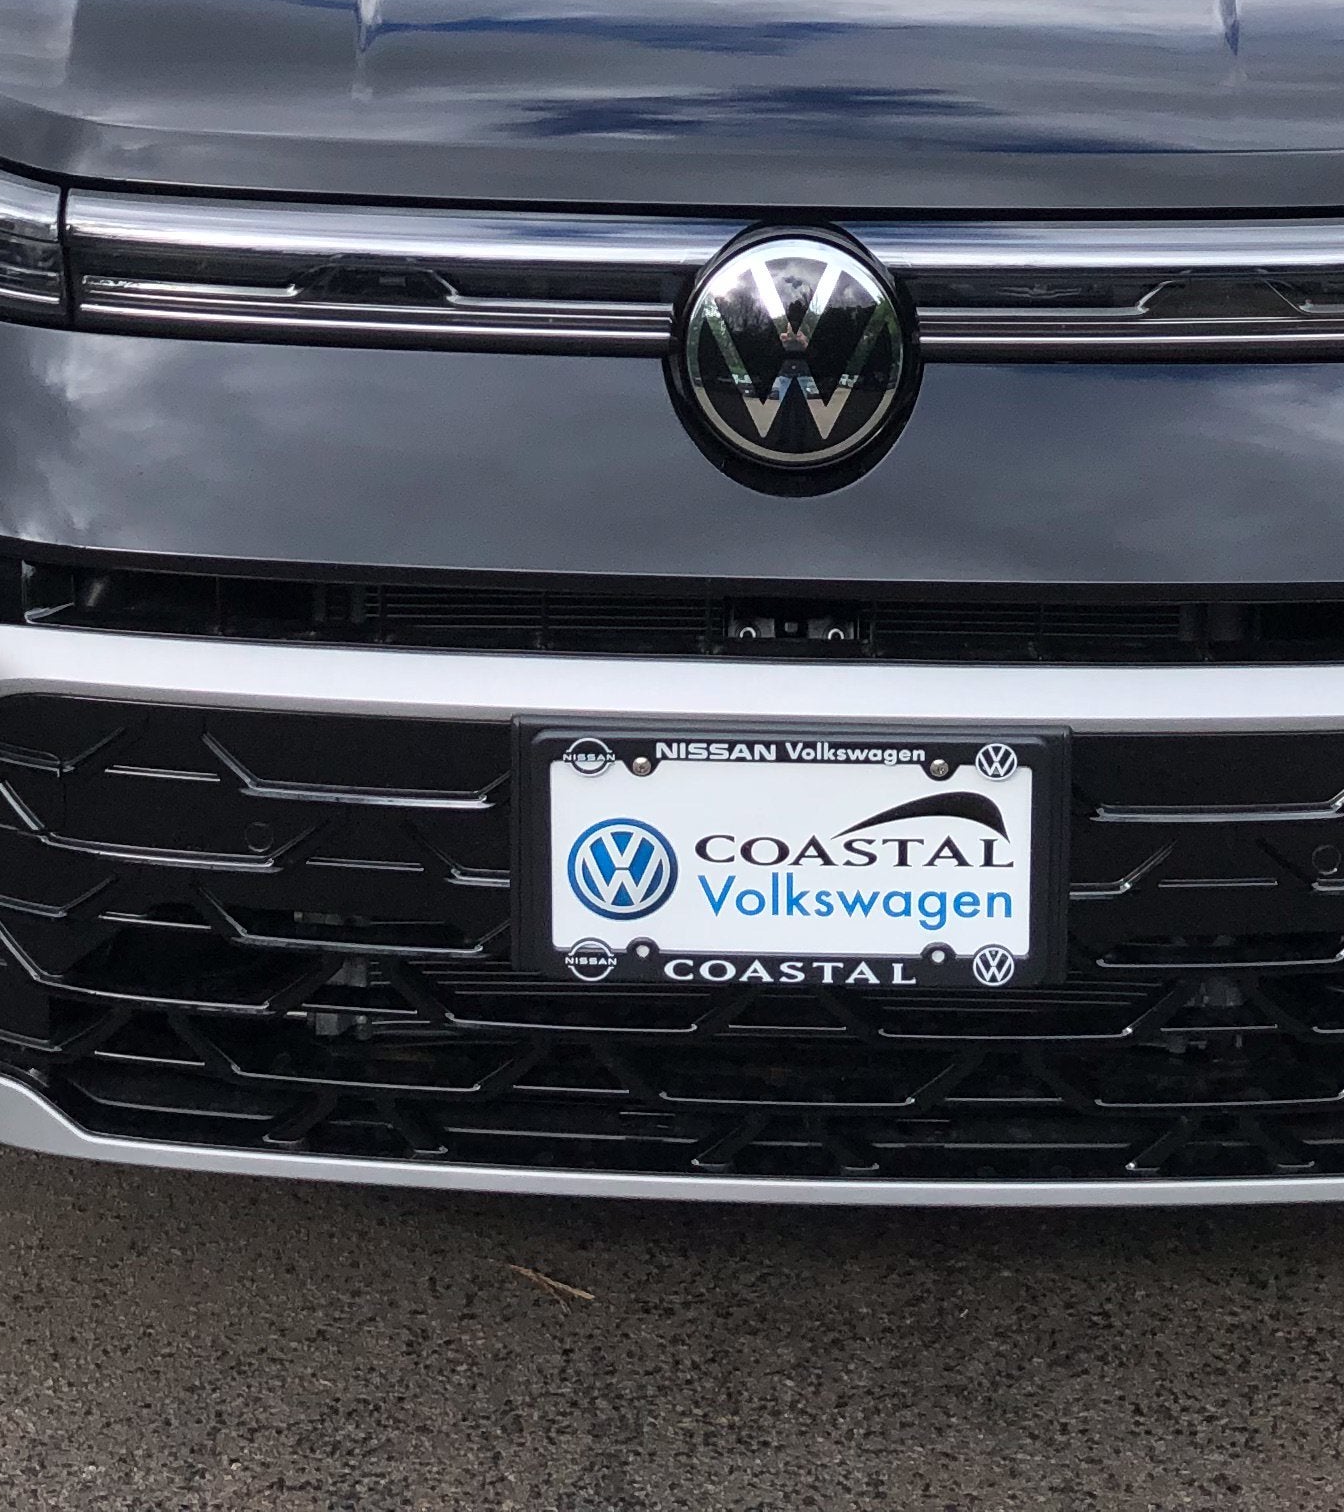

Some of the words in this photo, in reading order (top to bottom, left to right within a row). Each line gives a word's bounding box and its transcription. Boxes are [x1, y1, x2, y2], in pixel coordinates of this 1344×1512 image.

[562, 753, 616, 761] NISSAN
[655, 742, 777, 761] NISSAN
[784, 741, 926, 765] Volkswagen
[694, 834, 1014, 868] COASTAL
[697, 871, 1012, 931] Volkswagen
[564, 956, 617, 966] NISSAN
[663, 959, 917, 985] COASTAL
